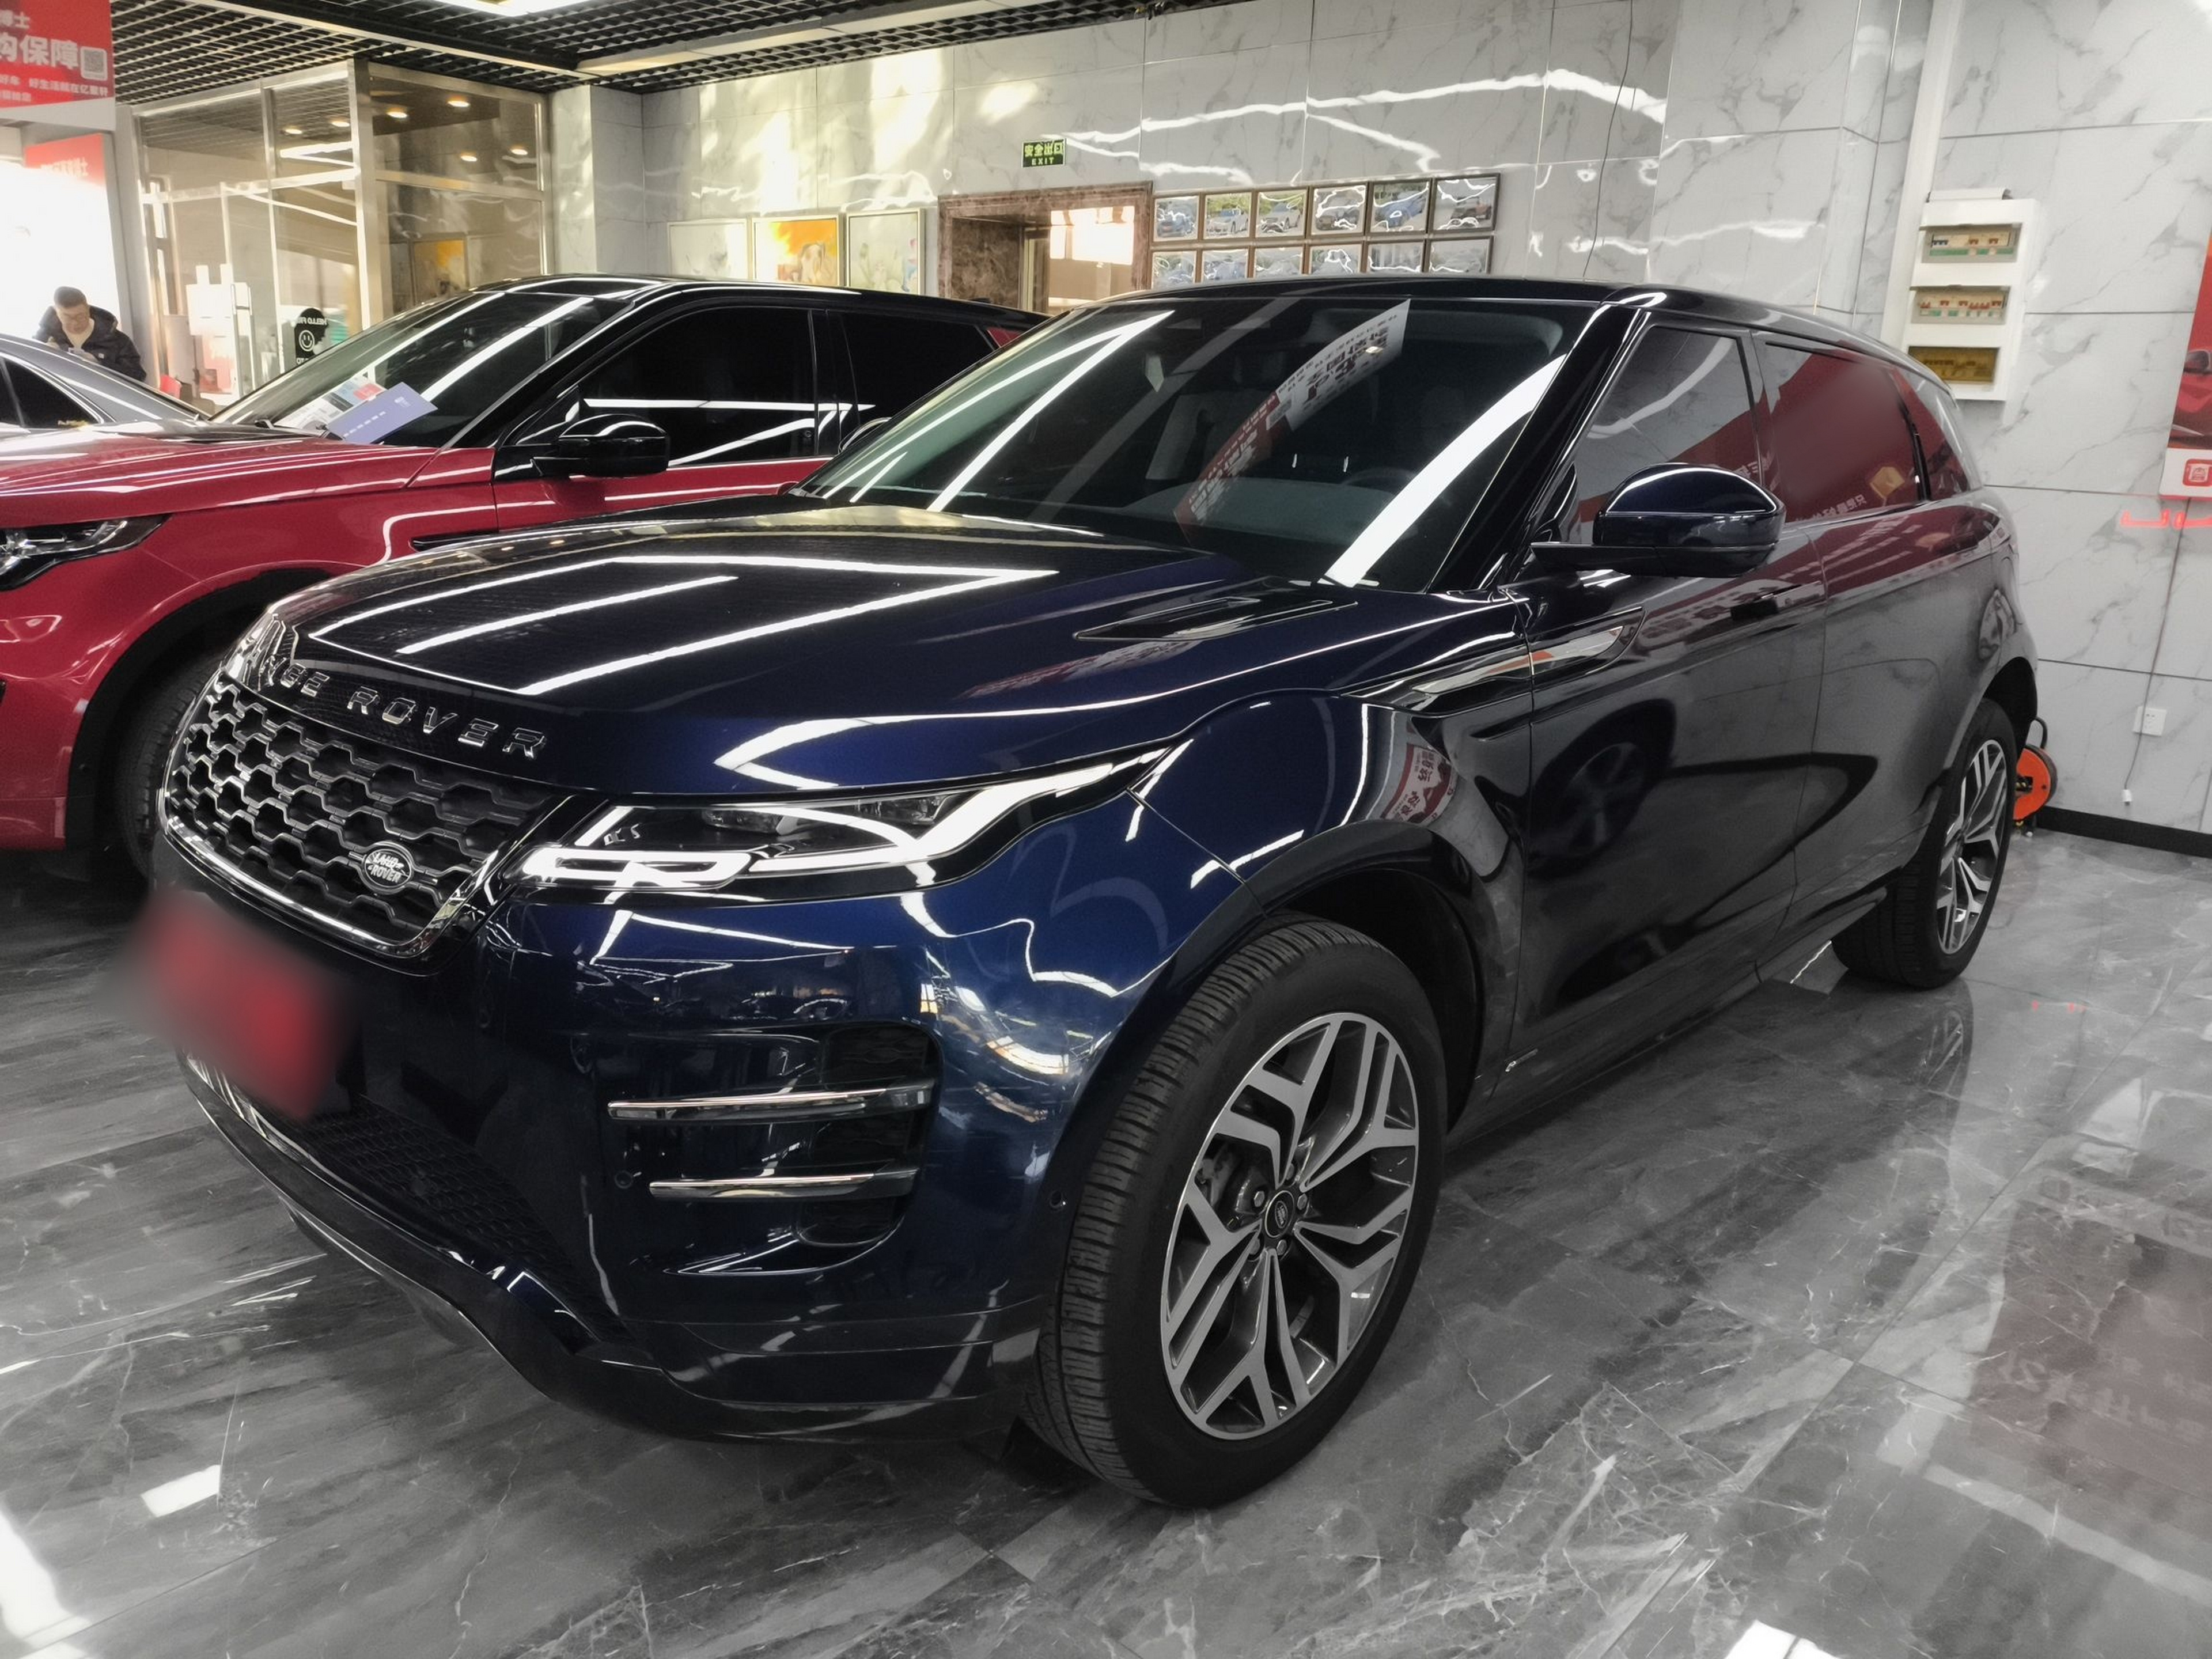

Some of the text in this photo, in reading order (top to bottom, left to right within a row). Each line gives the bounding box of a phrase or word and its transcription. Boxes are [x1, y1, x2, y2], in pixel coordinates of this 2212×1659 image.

[1032, 157, 1054, 165] EXIT
[347, 686, 546, 759] ROVER
[373, 853, 399, 869] LAND
[370, 865, 402, 883] ROVER
